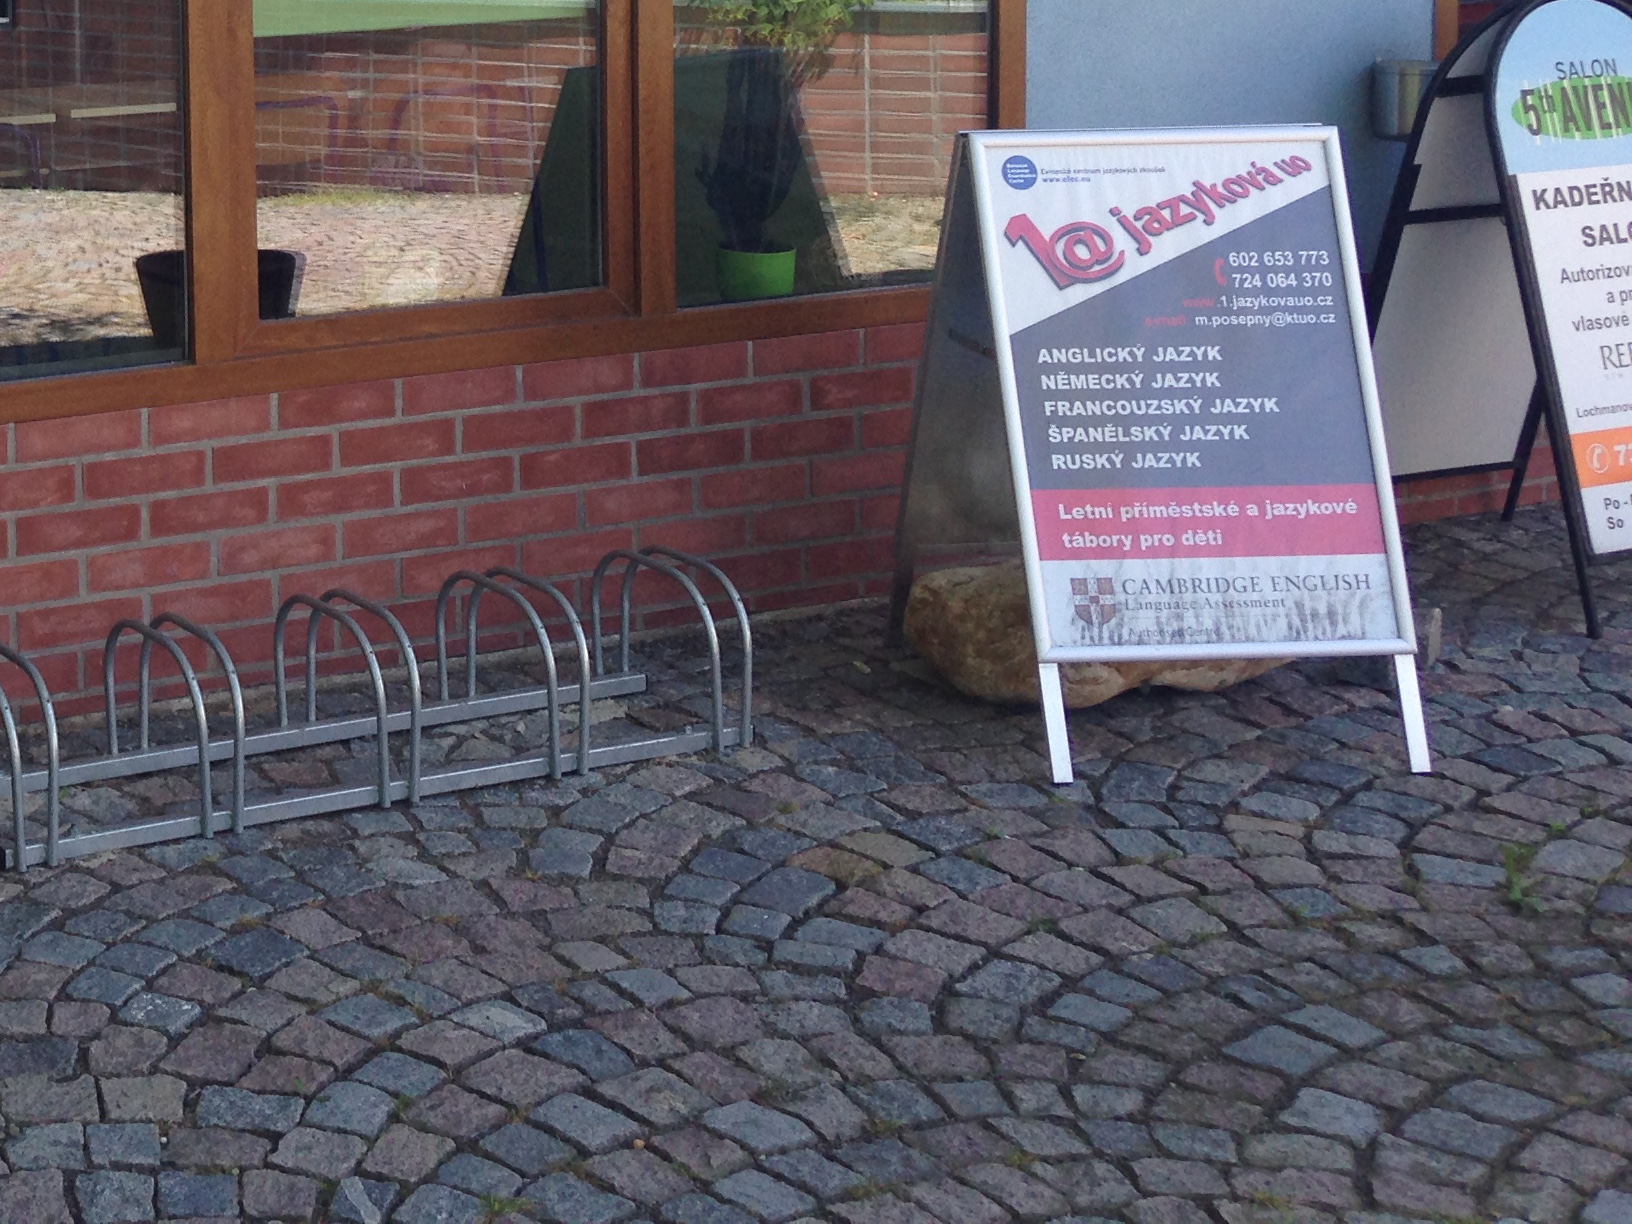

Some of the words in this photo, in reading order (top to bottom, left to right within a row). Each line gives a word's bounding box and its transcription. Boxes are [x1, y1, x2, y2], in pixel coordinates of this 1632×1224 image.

[1555, 57, 1618, 81] SALON
[1109, 160, 1284, 257] jazyková
[1273, 153, 1314, 178] uo
[1228, 251, 1259, 267] 602
[1263, 251, 1294, 266] 653
[1298, 250, 1330, 265] 773
[1231, 273, 1262, 288] 724
[1267, 272, 1298, 287] 064
[1302, 272, 1333, 287] 370
[1560, 263, 1632, 285] Autorizov
[1606, 291, 1616, 304] a
[1195, 311, 1336, 328] m.posepny@ktuo.cz
[1571, 309, 1630, 333] vlasové
[1037, 344, 1146, 364] ANGLICKÝ
[1152, 346, 1223, 362] JAZYK
[1041, 370, 1144, 389] NĚMECKÝ
[1151, 372, 1222, 388] JAZYK
[1044, 396, 1203, 416] FRANCOUZSKÝ
[1210, 397, 1280, 413] JAZYK
[1048, 422, 1172, 443] ŠPANĚLSKÝ
[1179, 424, 1250, 441] JAZYK
[1051, 449, 1125, 470] RUSKÝ
[1131, 451, 1202, 468] JAZYK
[1057, 502, 1113, 520] Letní
[1120, 501, 1240, 522] příměstské
[1246, 503, 1259, 517] a
[1265, 498, 1358, 520] jazykové
[1604, 497, 1621, 511] Po
[1607, 516, 1624, 530] So
[1062, 531, 1133, 551] tábory
[1139, 533, 1175, 550] pro
[1181, 529, 1223, 547] děti
[1121, 575, 1263, 596] CAMBRIDGE
[1272, 573, 1372, 593] ENGLISH
[1125, 598, 1197, 614] Language
[1204, 596, 1287, 610] Assessment
